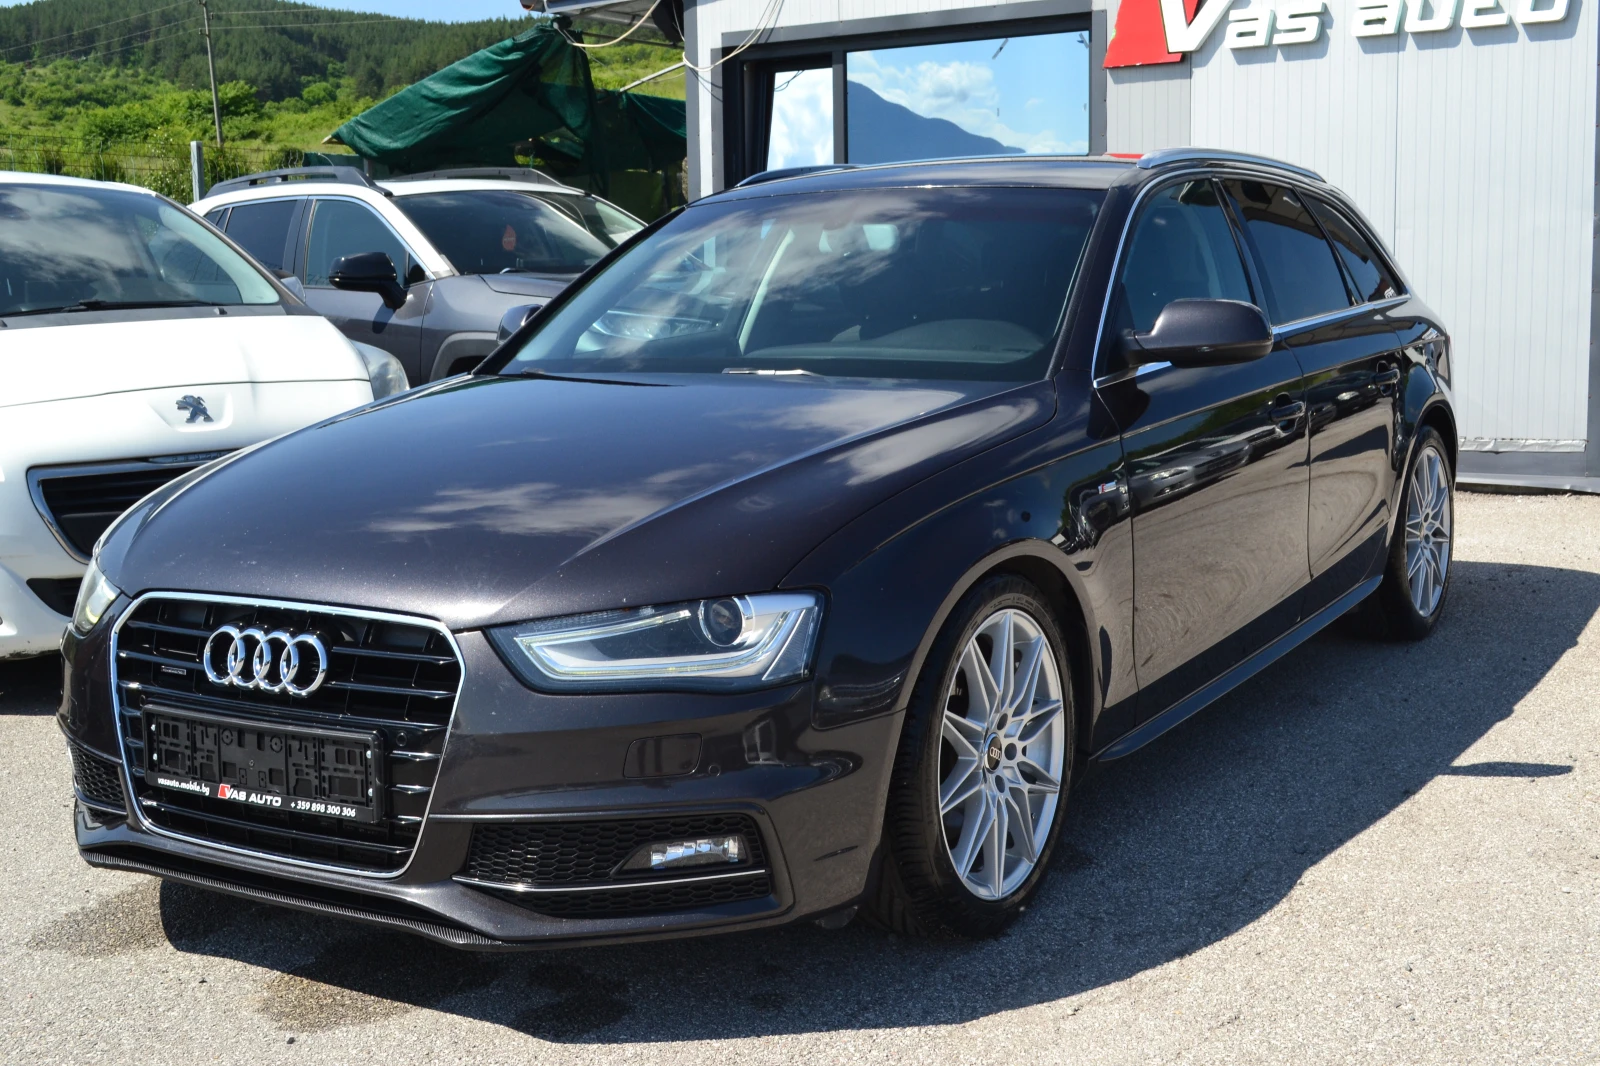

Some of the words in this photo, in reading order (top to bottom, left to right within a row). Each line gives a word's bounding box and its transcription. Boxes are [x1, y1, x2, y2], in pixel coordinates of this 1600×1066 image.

[157, 777, 210, 796] vasauto.mobile.bg
[248, 793, 282, 807] AUTO
[311, 802, 326, 813] 898
[326, 805, 341, 815] 300
[341, 807, 356, 817] 306
